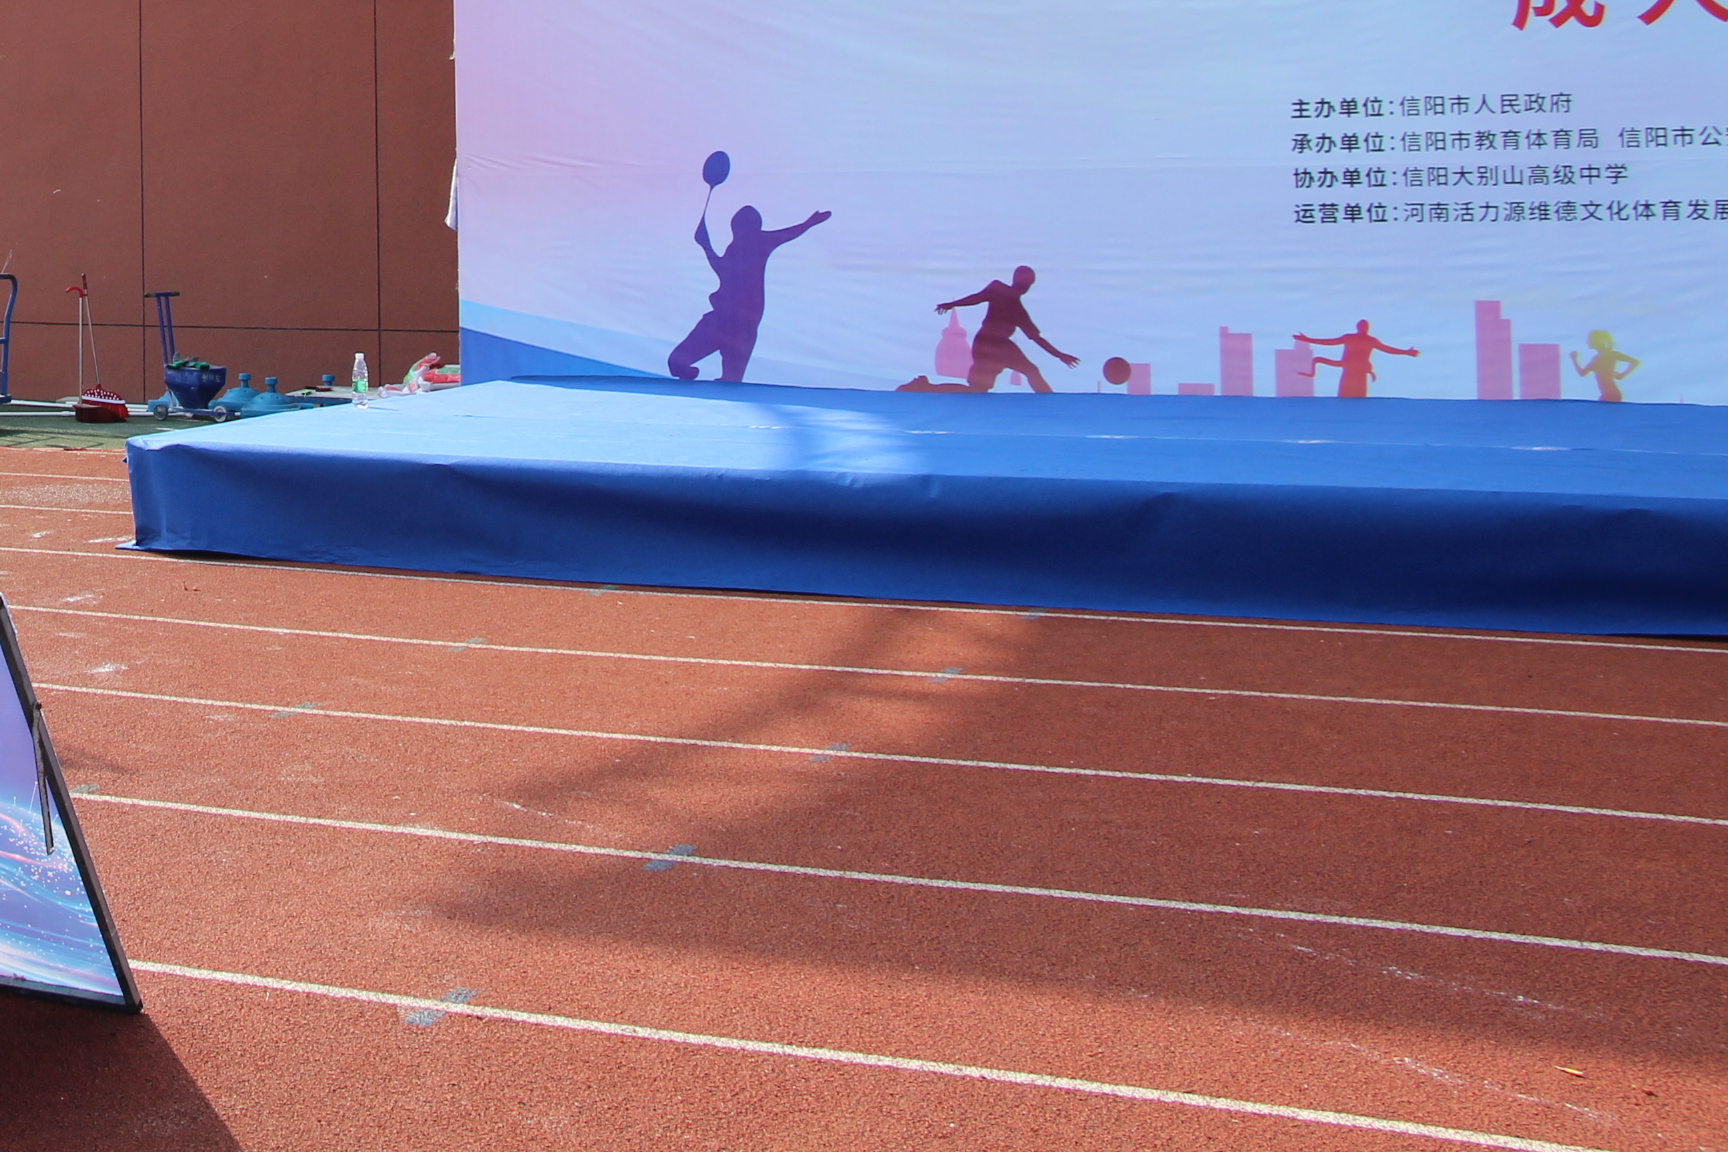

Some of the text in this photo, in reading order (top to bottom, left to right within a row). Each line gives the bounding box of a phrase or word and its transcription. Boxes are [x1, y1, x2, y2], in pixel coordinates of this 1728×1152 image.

[1290, 92, 1573, 119] 主办单位：信阳市人民政府
[1290, 126, 1728, 154] 承办单位：信阳市教育体育局 信阳市公
[1293, 163, 1629, 189] 协办单位：信阳大别山高级中学
